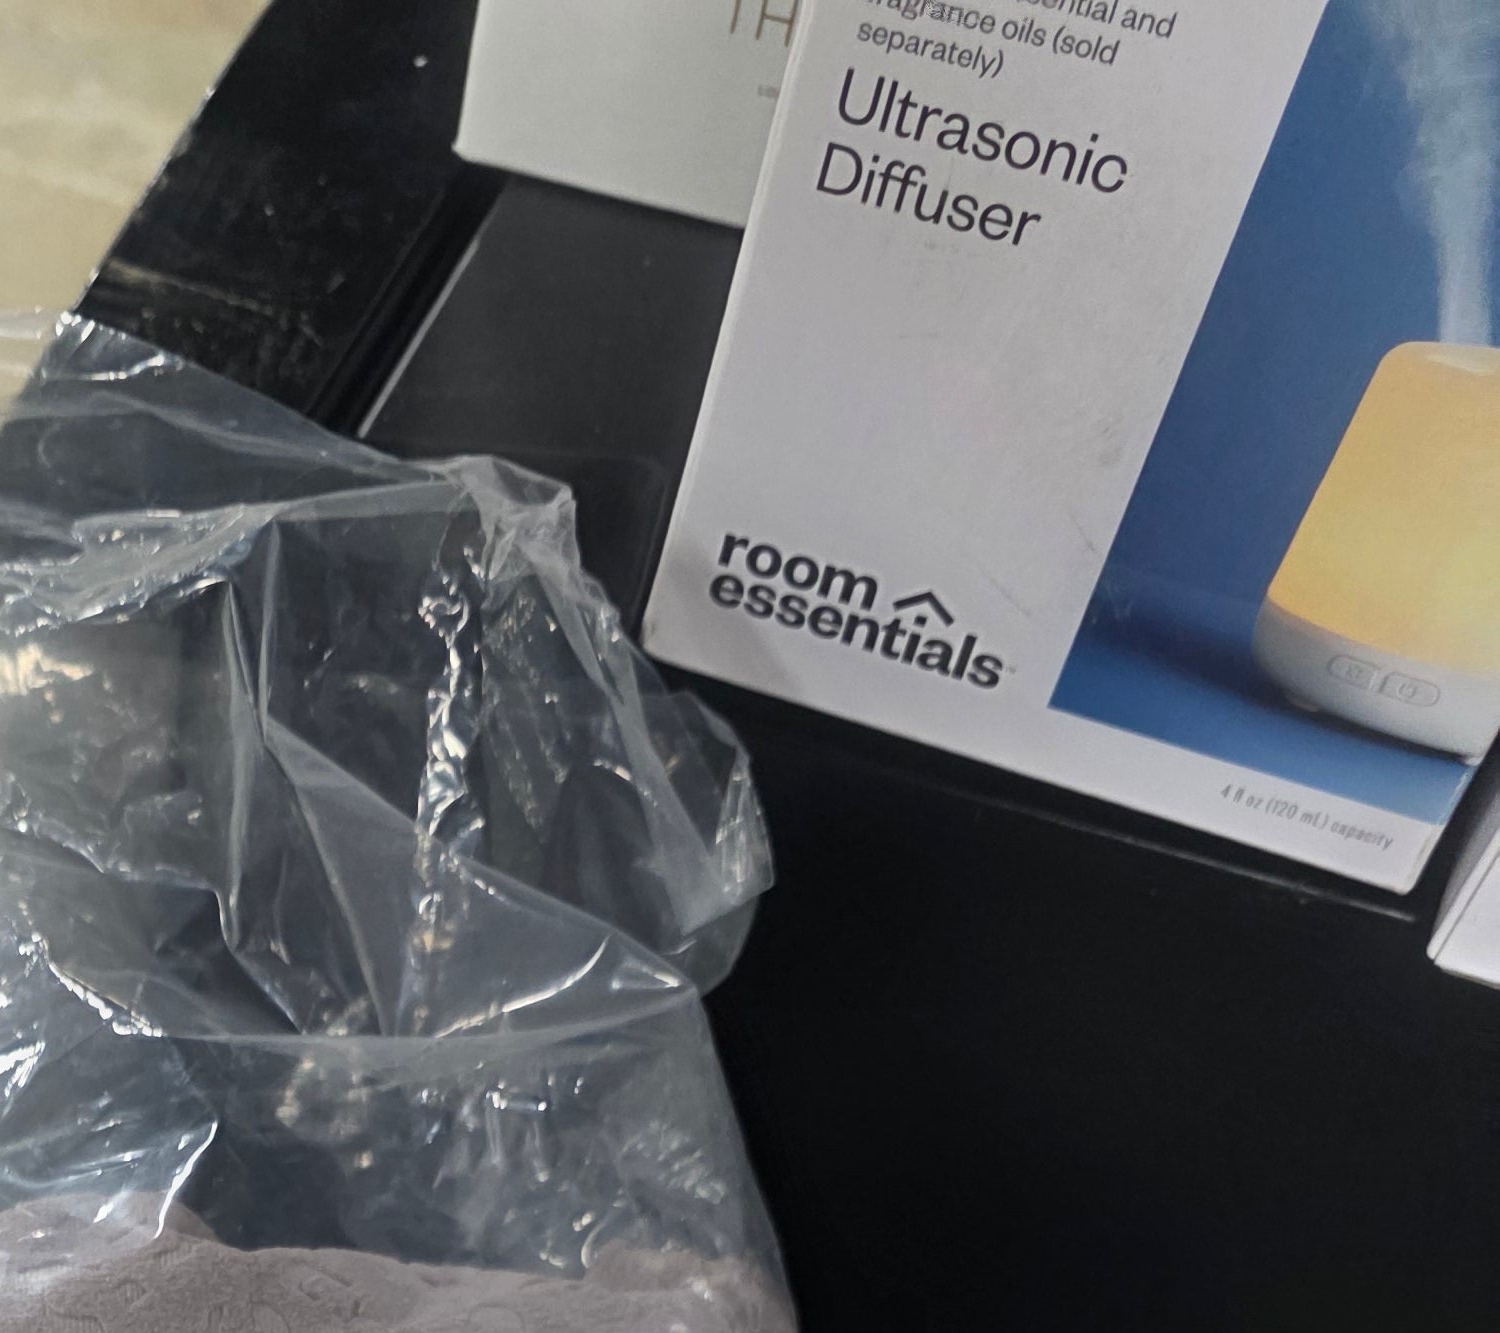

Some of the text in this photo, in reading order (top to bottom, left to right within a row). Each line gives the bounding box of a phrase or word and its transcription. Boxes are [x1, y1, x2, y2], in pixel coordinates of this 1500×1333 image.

[857, 22, 1004, 79] separately)
[867, 0, 1120, 67] agrance oils (sold
[1120, 9, 1177, 39] and
[837, 67, 1129, 194] Ultrasonic
[816, 142, 1042, 246] Diffuser
[717, 533, 879, 612] room
[708, 573, 1004, 689] essentials
[1220, 784, 1232, 799] 4
[1246, 795, 1263, 809] oz
[1265, 798, 1299, 820] (120
[1330, 820, 1394, 850] capacity
